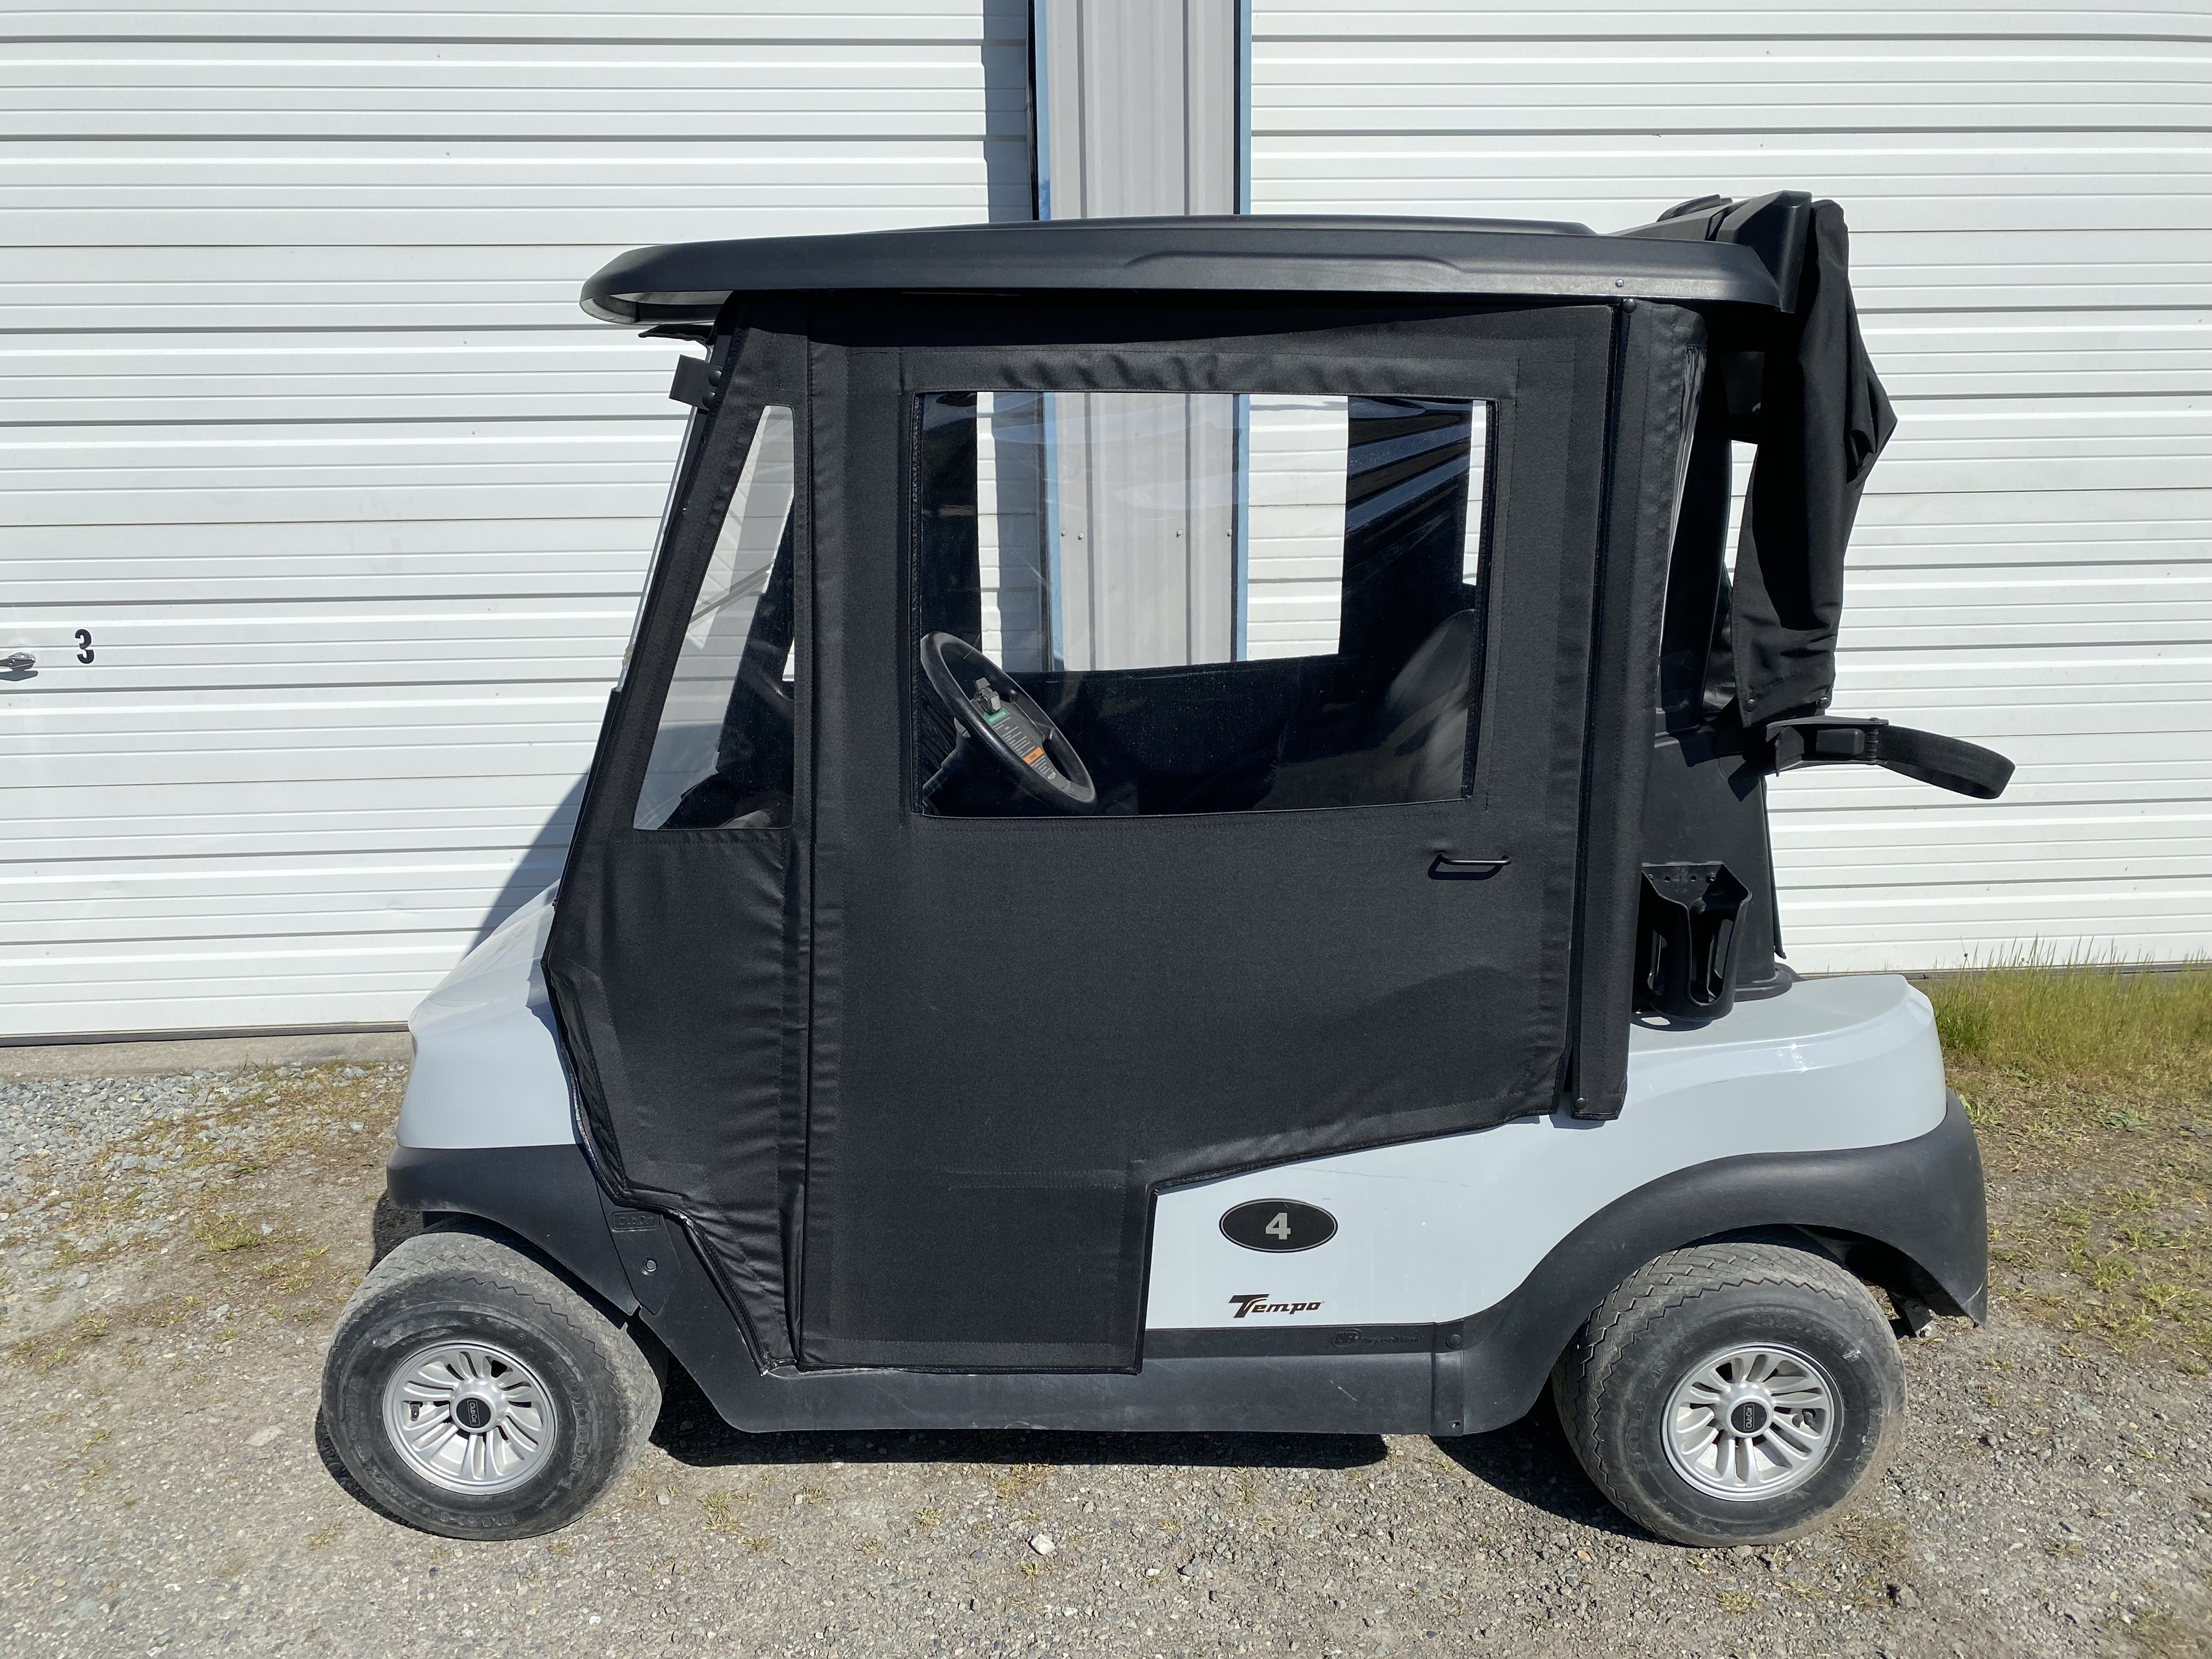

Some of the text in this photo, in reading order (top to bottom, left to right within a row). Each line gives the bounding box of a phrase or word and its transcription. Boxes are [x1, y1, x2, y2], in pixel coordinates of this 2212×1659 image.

[74, 629, 95, 664] 3
[618, 1215, 654, 1225] Club Car
[1265, 1212, 1291, 1240] 4
[1228, 1293, 1323, 1318] Tempo
